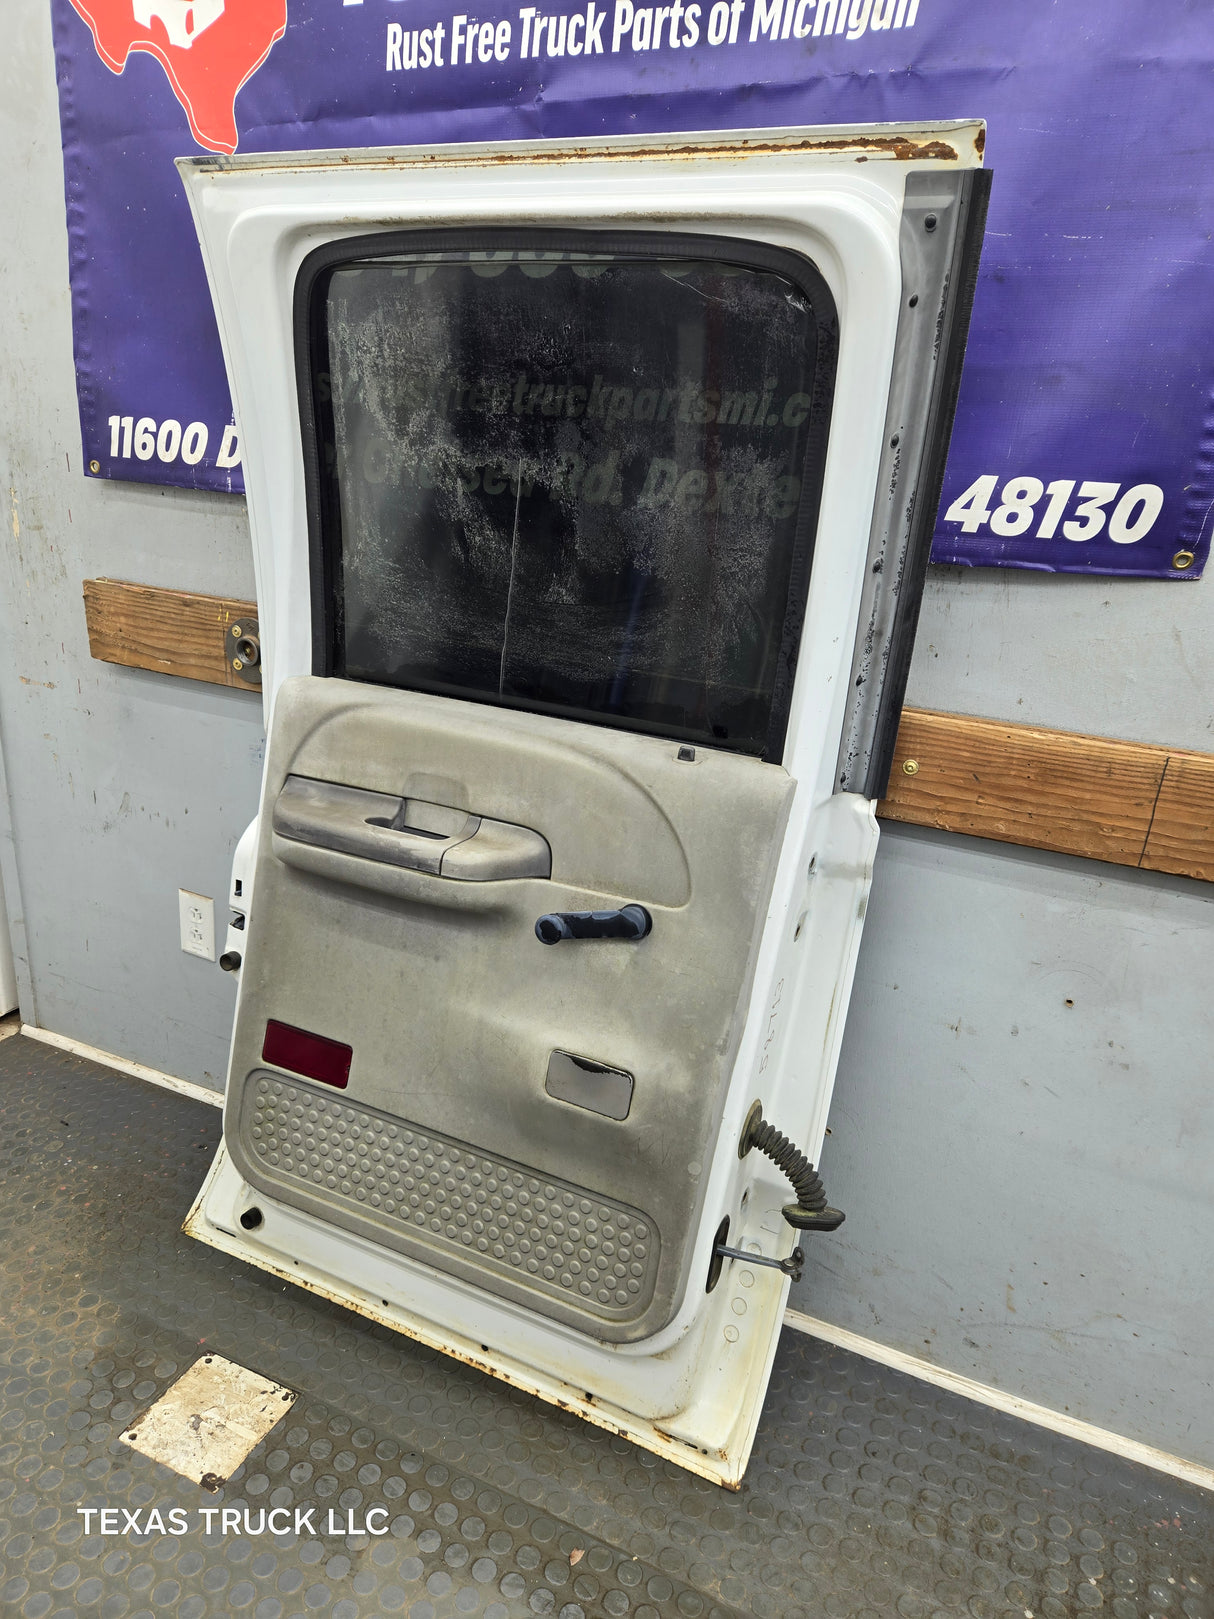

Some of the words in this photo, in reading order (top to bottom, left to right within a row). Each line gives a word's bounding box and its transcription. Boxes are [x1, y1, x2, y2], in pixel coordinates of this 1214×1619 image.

[386, 22, 446, 71] Rust
[450, 15, 512, 65] Free
[519, 1, 607, 59] Truck
[611, 0, 702, 53] Parts
[707, 0, 746, 46] of
[108, 415, 209, 465] 11600
[944, 474, 1164, 544] 48130
